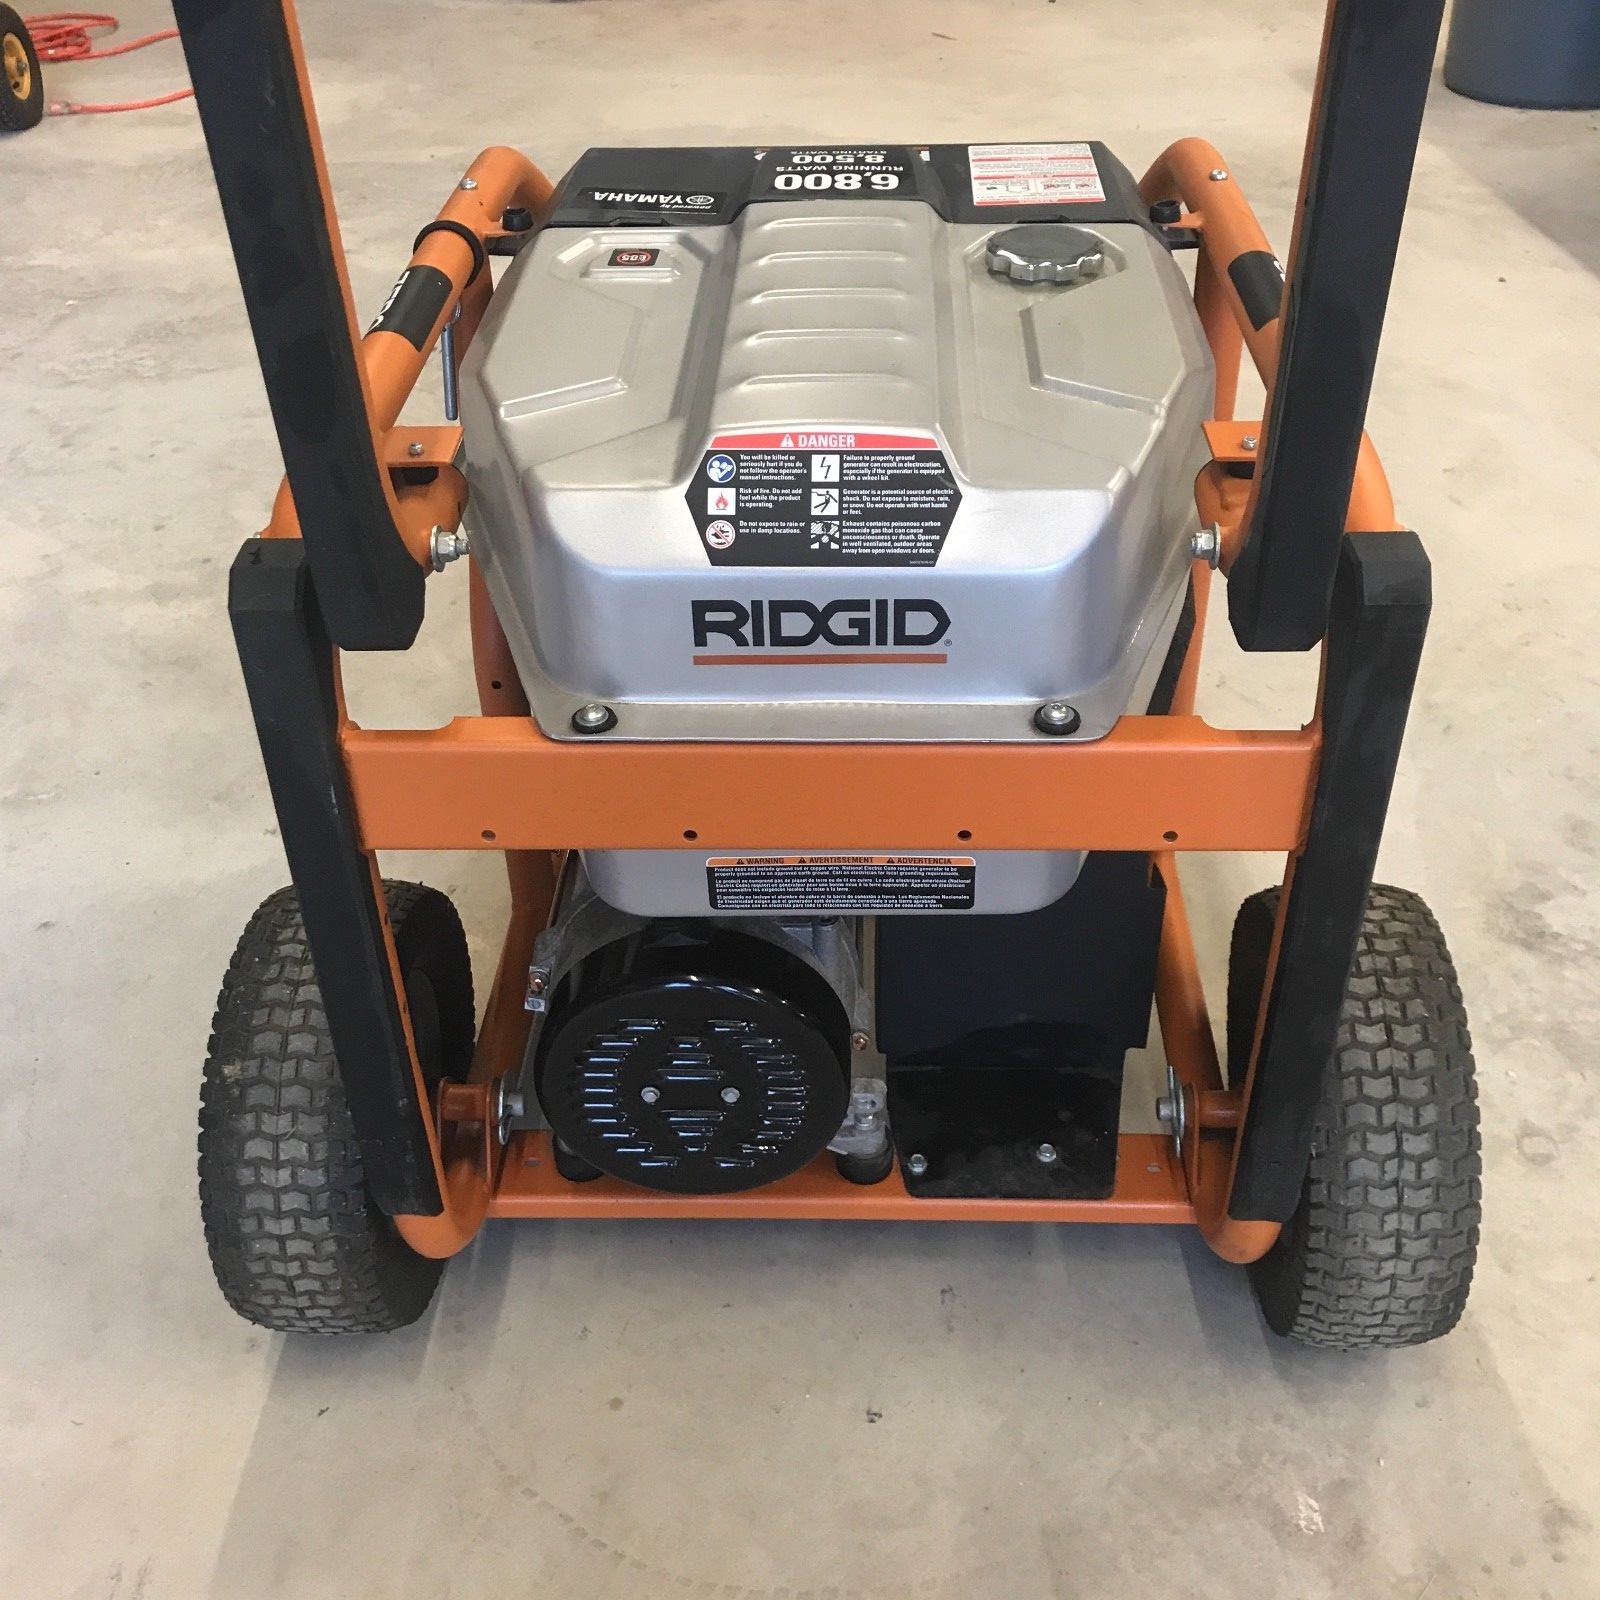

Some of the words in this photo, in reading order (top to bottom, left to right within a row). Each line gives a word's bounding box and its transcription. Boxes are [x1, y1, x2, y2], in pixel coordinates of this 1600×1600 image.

[792, 153, 885, 164] 8,500
[774, 171, 900, 191] 6,800
[594, 191, 683, 204] YAMAHA
[798, 434, 856, 448] DANGER
[691, 598, 952, 648] RIDGID
[897, 857, 952, 865] ADVERTENCIA
